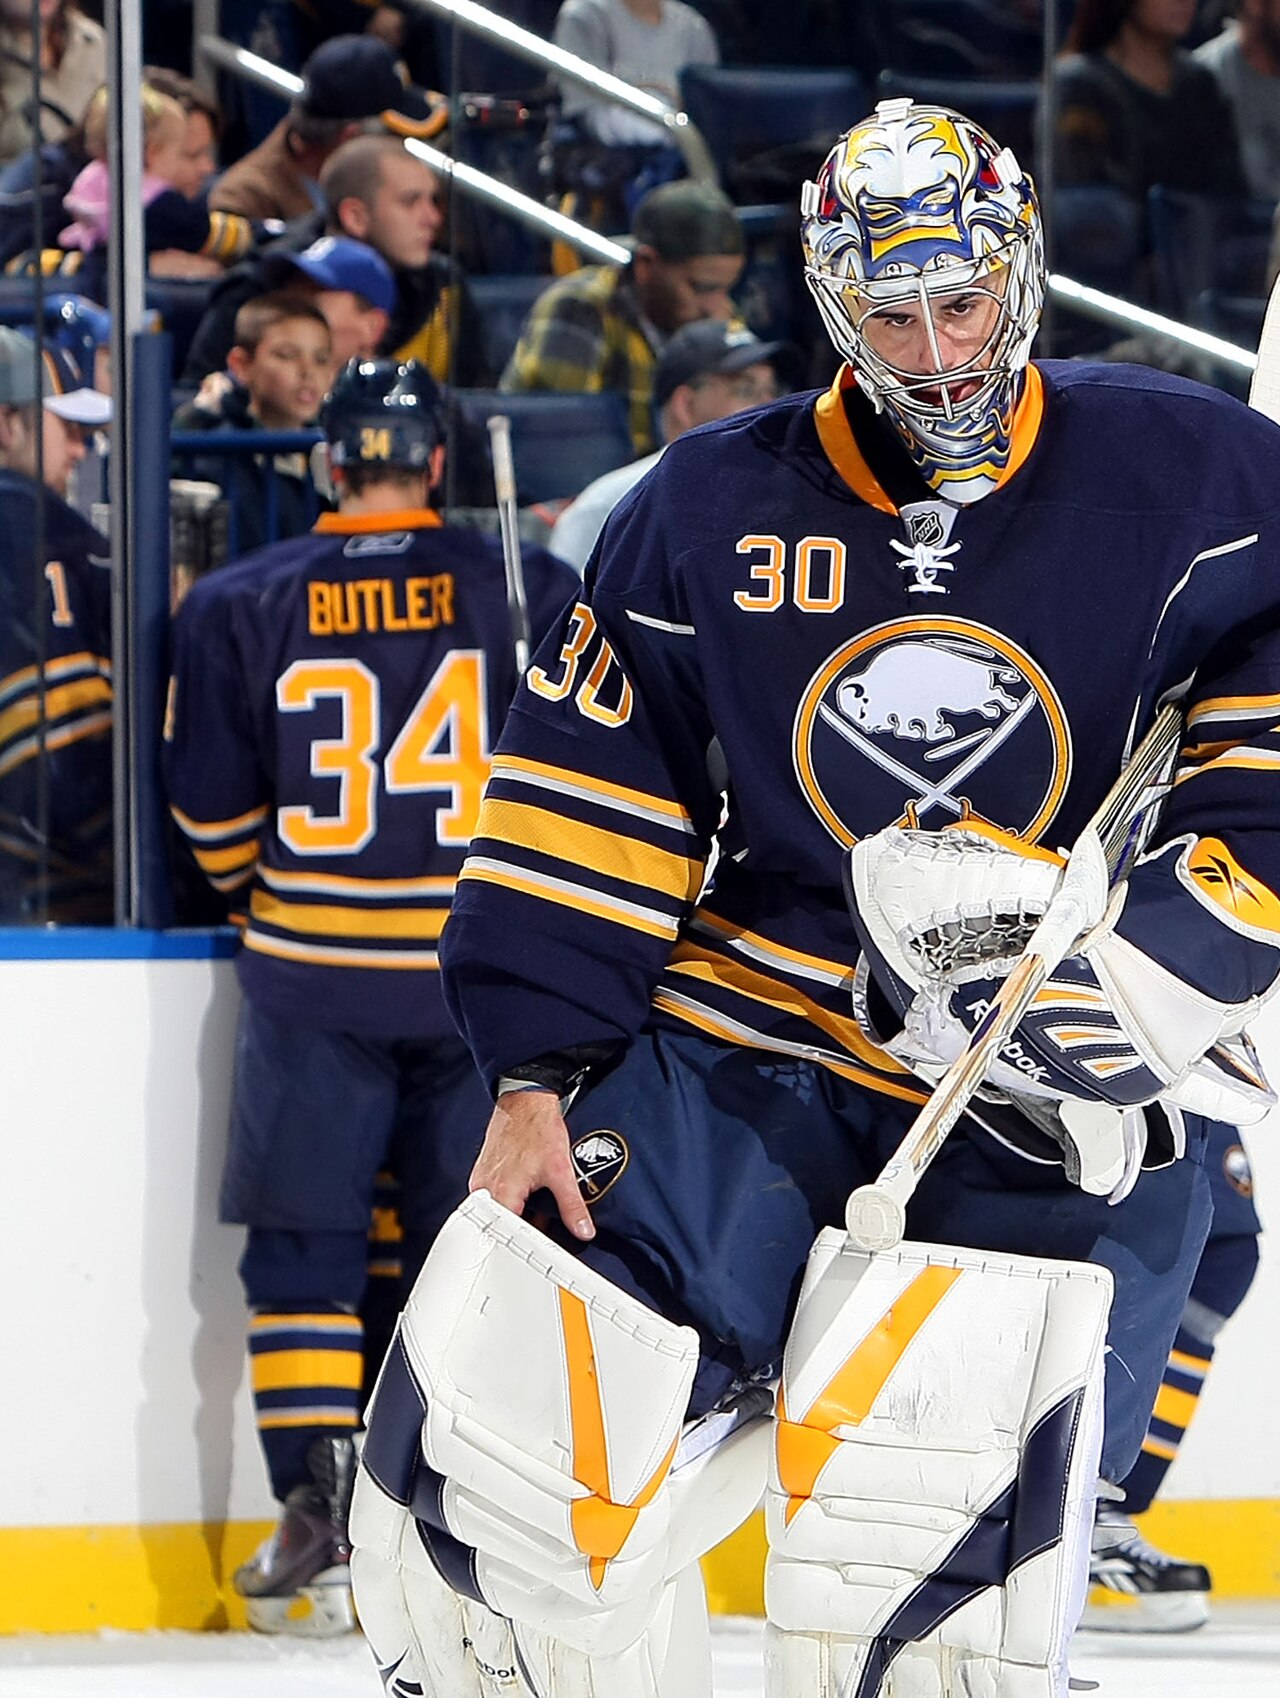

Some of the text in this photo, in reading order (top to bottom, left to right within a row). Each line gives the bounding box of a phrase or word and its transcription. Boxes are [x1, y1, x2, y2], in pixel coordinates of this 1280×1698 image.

[360, 427, 392, 461] 34
[916, 518, 939, 541] NHL
[307, 572, 455, 636] BUTLER
[734, 534, 847, 613] 30
[526, 602, 633, 728] 30
[276, 649, 495, 857] 34
[965, 999, 1052, 1081] Rbok
